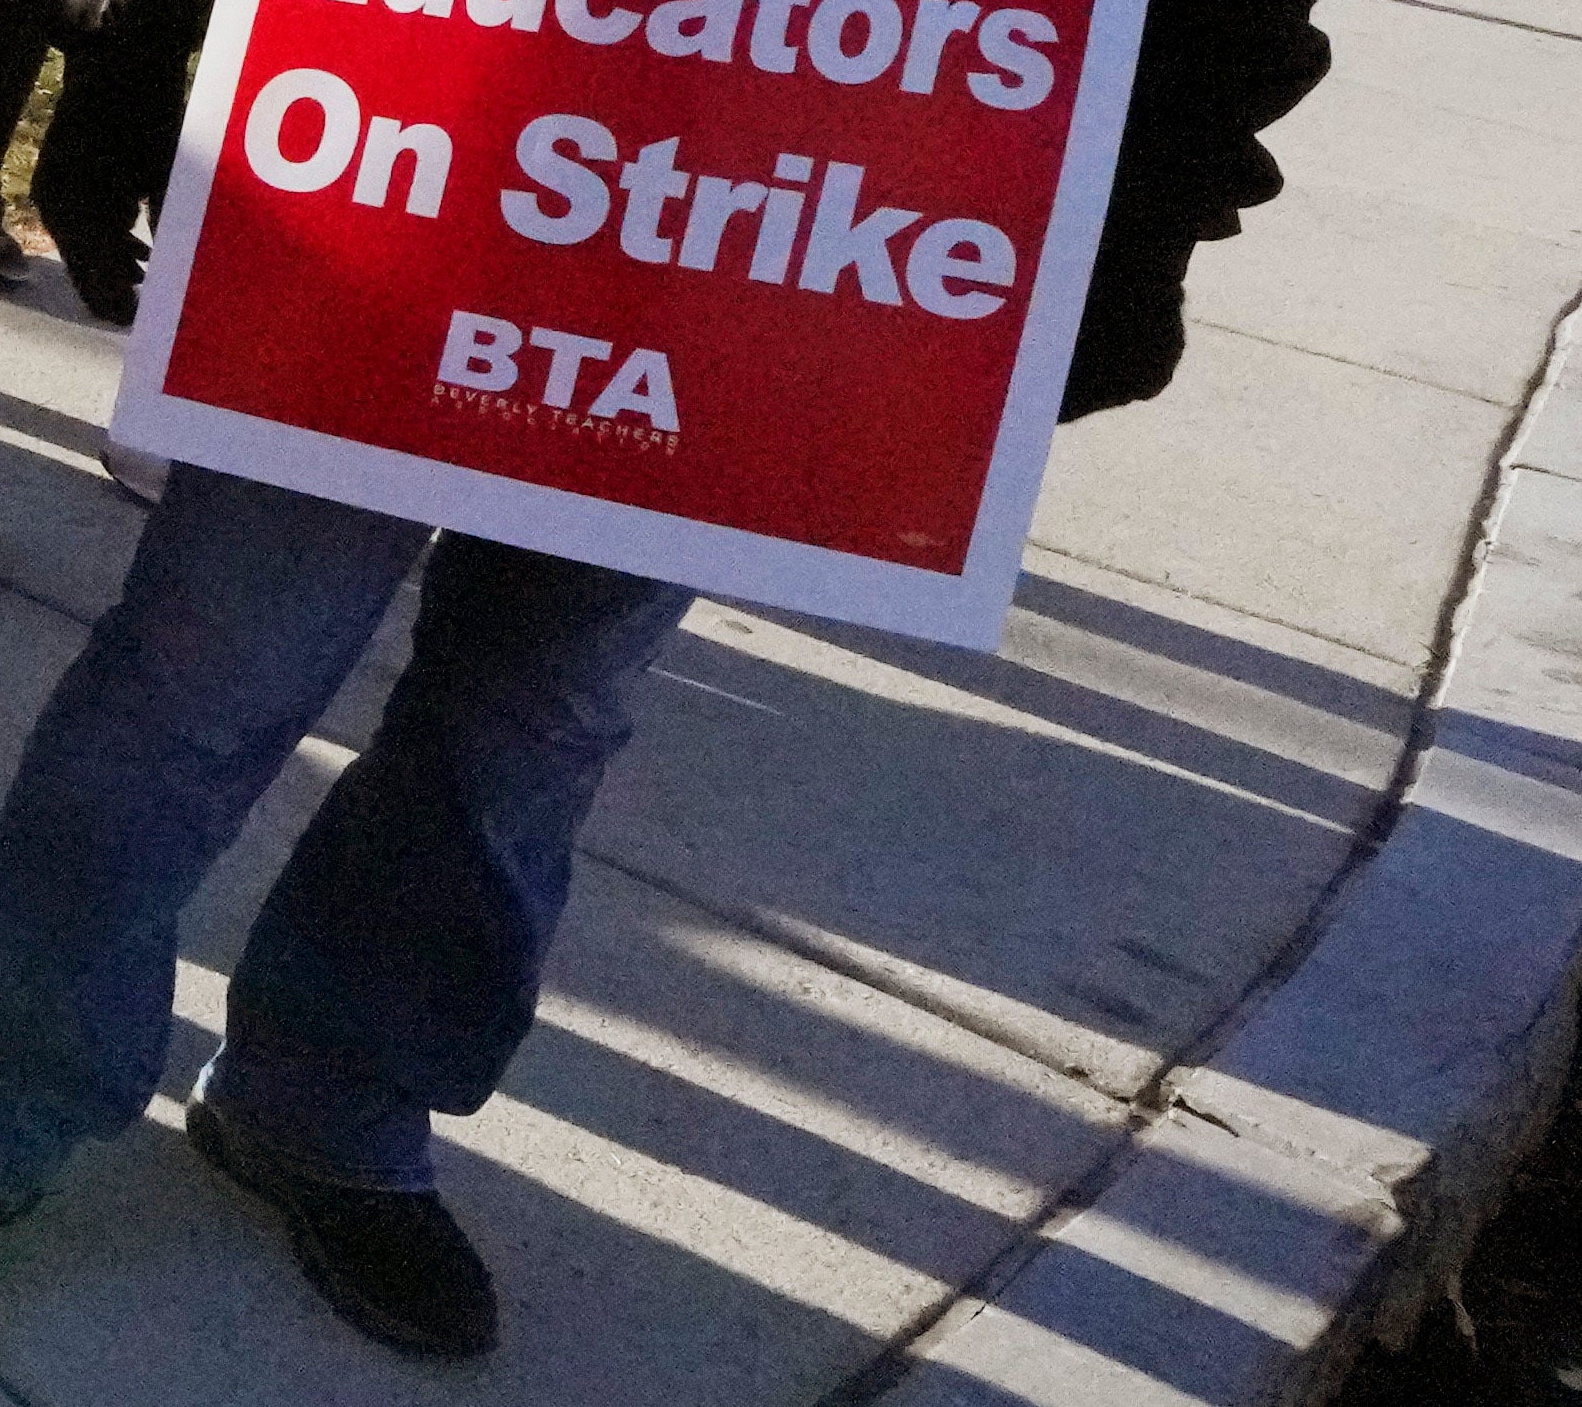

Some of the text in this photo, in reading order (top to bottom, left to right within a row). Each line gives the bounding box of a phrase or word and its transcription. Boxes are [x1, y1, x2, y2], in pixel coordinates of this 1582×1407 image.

[244, 67, 1017, 320] On Strike
[437, 310, 680, 433] BTA
